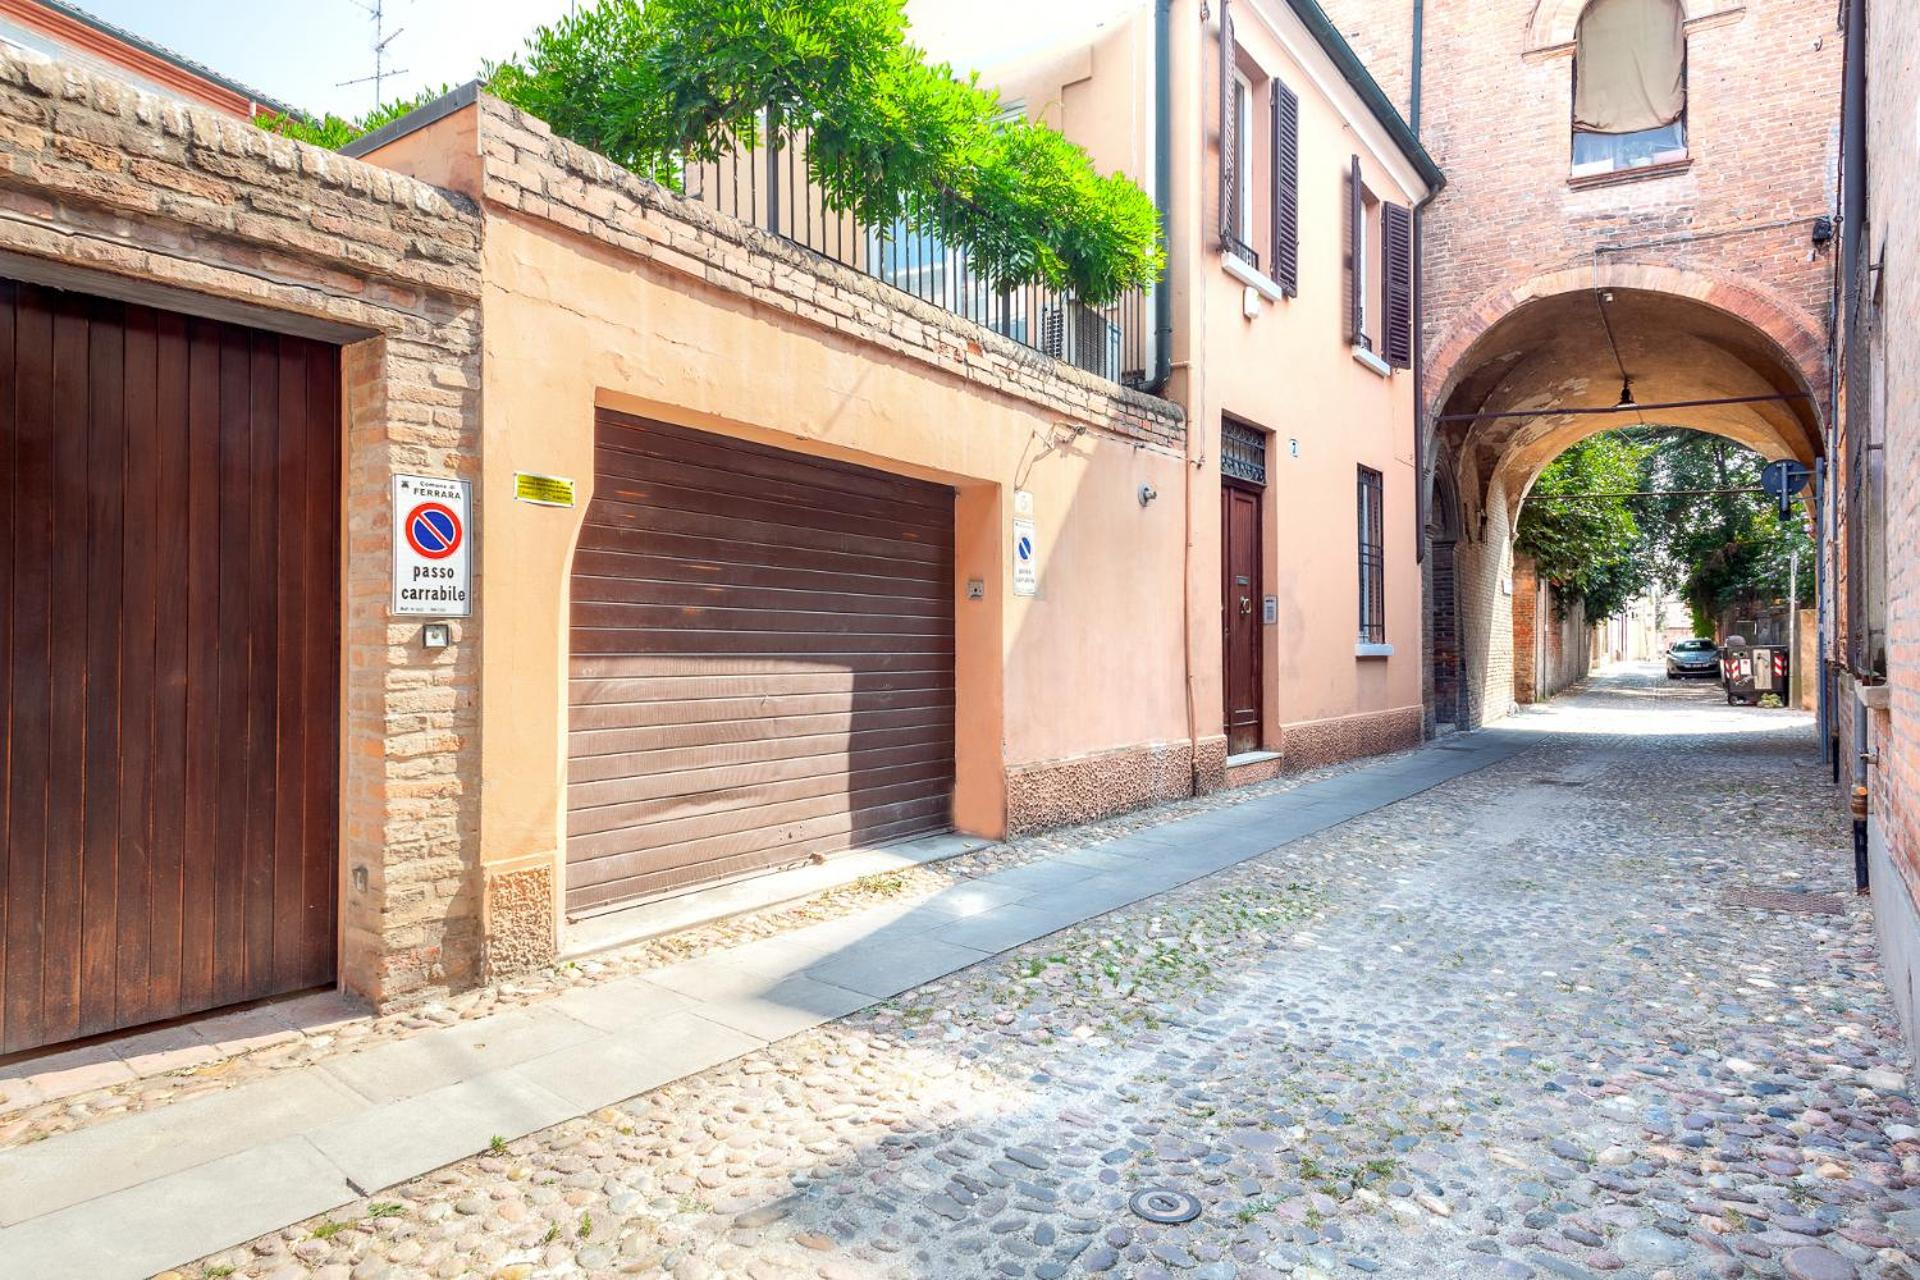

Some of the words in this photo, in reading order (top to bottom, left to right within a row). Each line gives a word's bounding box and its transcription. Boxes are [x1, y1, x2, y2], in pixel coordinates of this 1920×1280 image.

[413, 488, 461, 500] FERRARA
[413, 565, 454, 581] passo
[401, 585, 466, 602] carrabile
